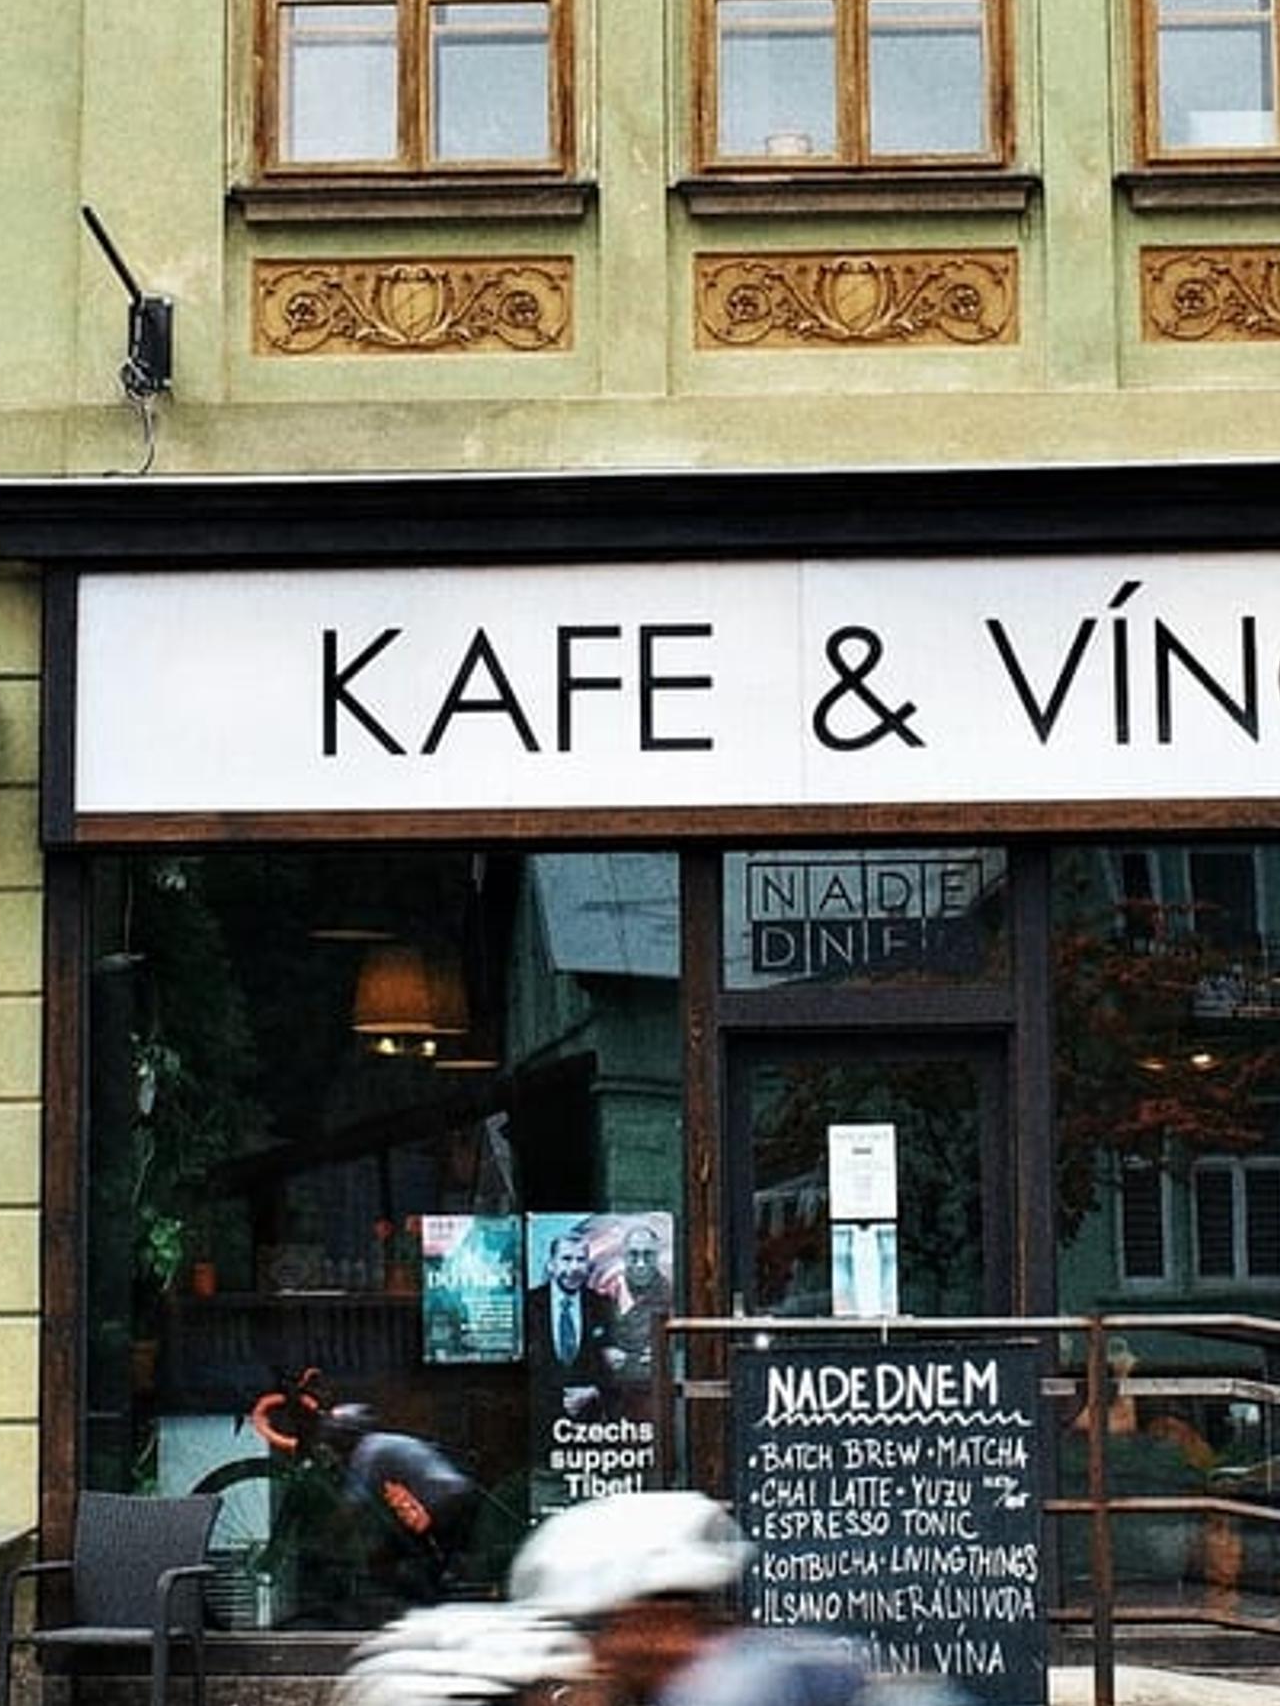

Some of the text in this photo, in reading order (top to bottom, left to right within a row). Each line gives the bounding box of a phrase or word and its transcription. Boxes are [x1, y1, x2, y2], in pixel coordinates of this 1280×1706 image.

[321, 623, 714, 756] KAFE
[812, 625, 927, 752] &
[762, 869, 964, 913] NADE
[552, 1417, 655, 1444] Czechs
[759, 1436, 1029, 1473] BATCH BREW MATCHA
[761, 1477, 818, 1509] CHAI
[830, 1476, 894, 1509] LATTE
[911, 1474, 972, 1508] YUZU
[765, 1508, 980, 1541] ESPRESSO TONIC
[764, 1550, 879, 1583] KOMBUCHA
[933, 1621, 1006, 1675] VÍNA
